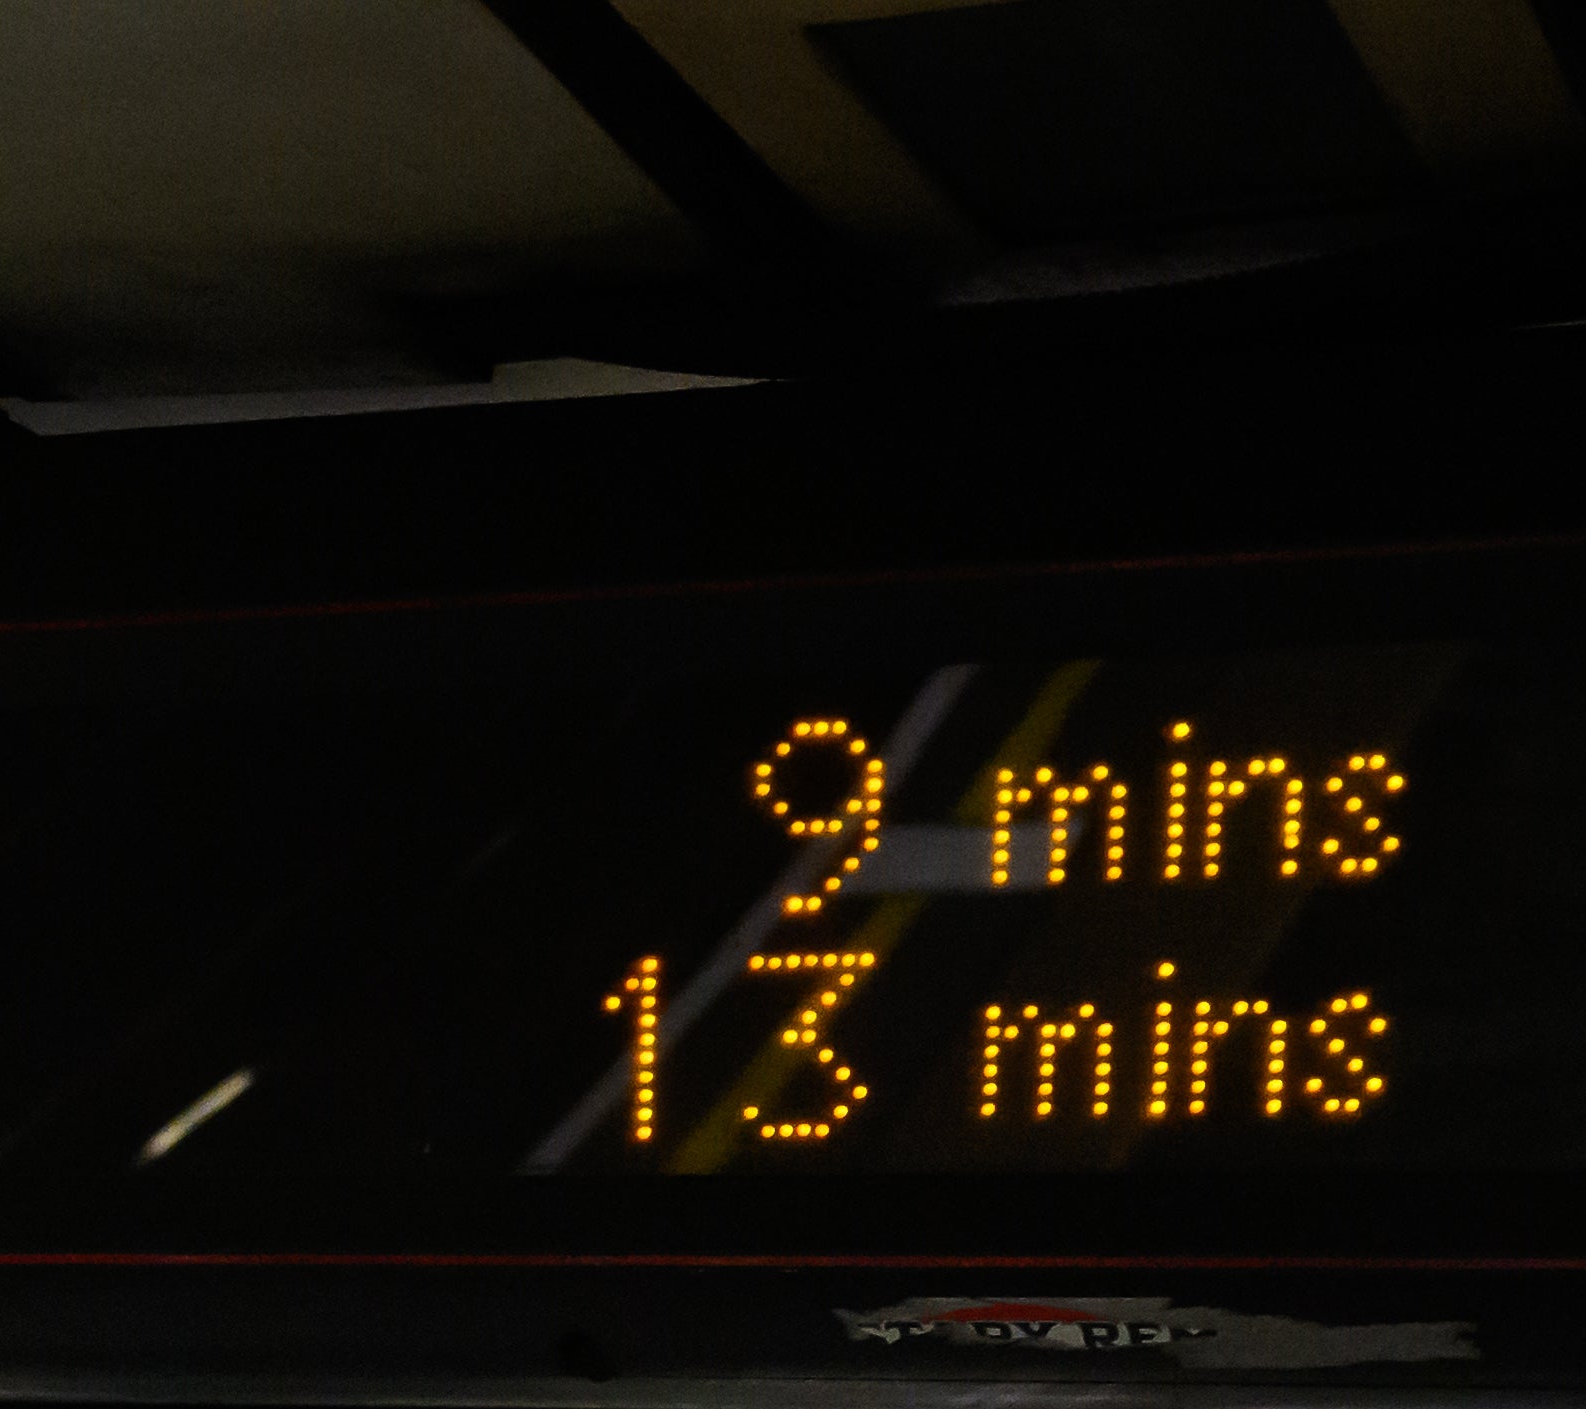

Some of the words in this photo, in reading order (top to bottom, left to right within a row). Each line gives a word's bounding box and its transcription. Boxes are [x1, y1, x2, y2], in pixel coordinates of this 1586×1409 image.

[751, 716, 887, 918] 9
[987, 719, 1408, 889] mins
[601, 947, 879, 1144] 13
[977, 958, 1389, 1121] mins
